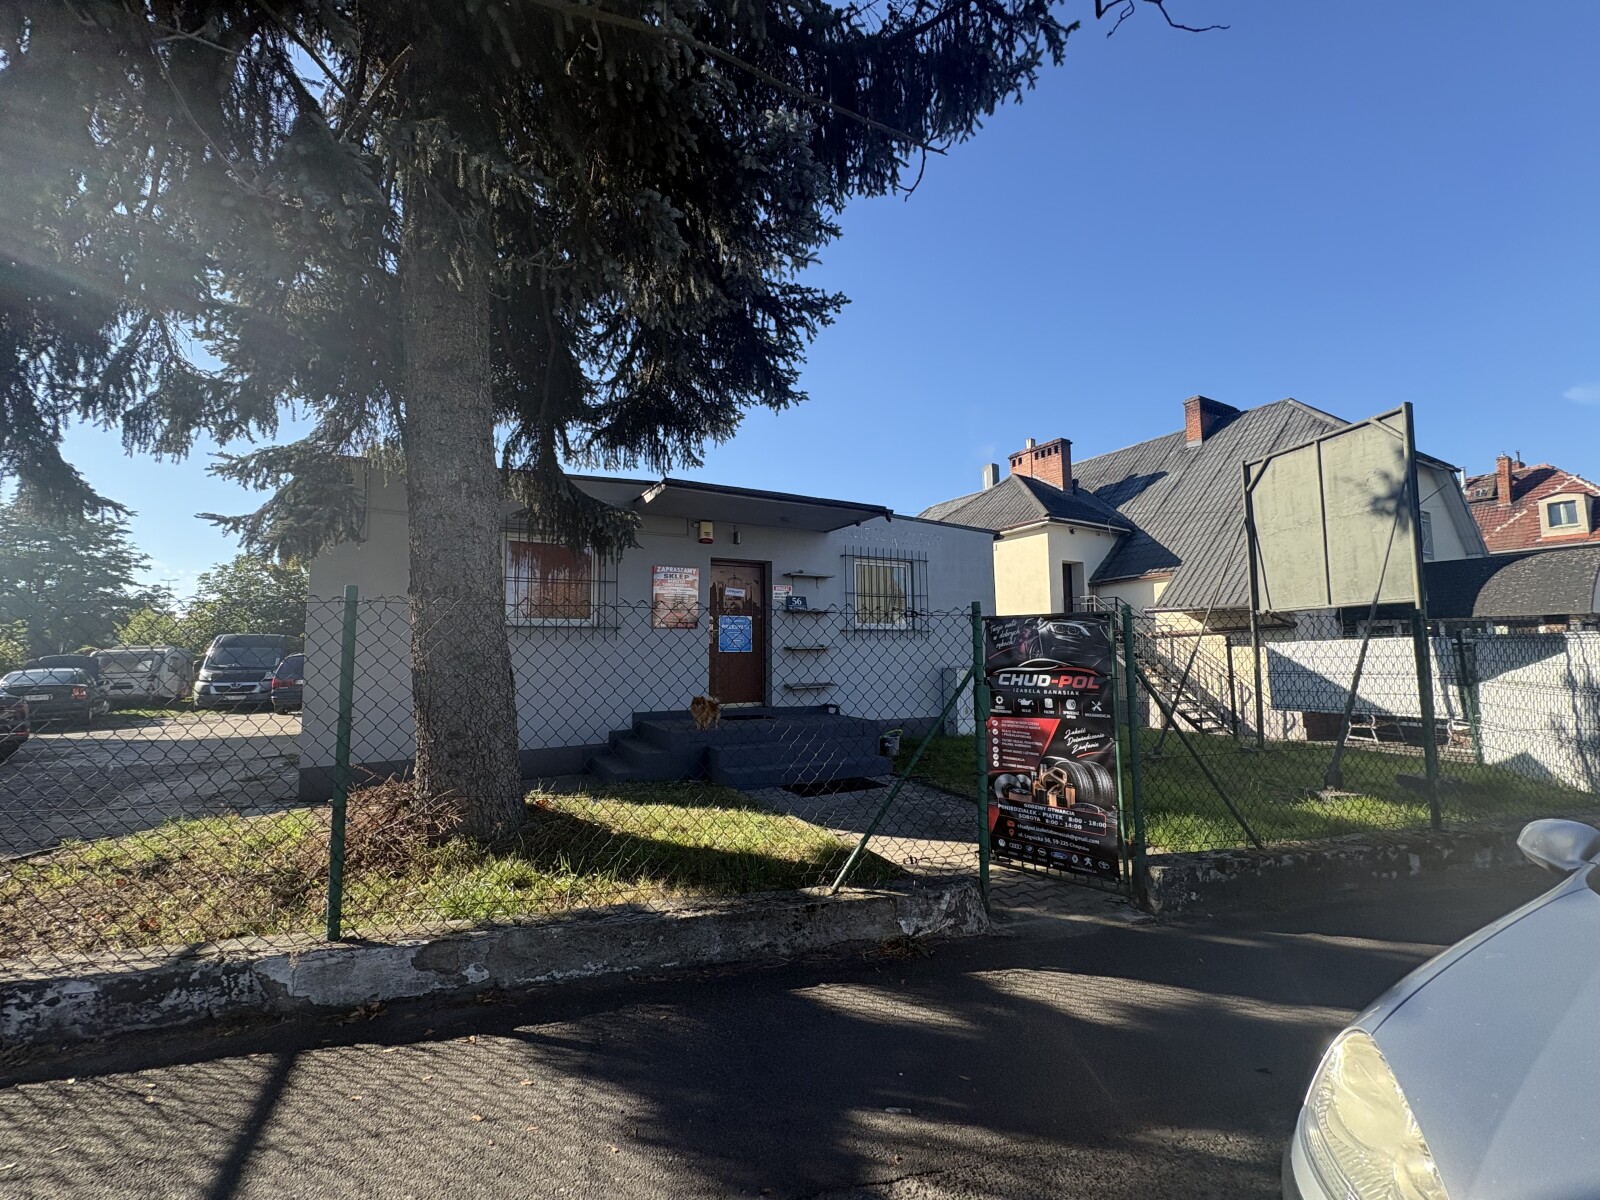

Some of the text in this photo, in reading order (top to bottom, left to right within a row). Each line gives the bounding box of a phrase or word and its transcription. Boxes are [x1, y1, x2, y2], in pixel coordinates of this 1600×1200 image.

[656, 566, 696, 574] ZAPRASZAMY
[998, 674, 1100, 689] CHUD-POL
[1071, 742, 1099, 754] Zaufanie
[998, 803, 1037, 816] PONIEDZIAŁEK
[1089, 820, 1107, 828] 18:00
[1047, 808, 1075, 816] OTWARCIA
[1018, 813, 1041, 822] SOBOTA
